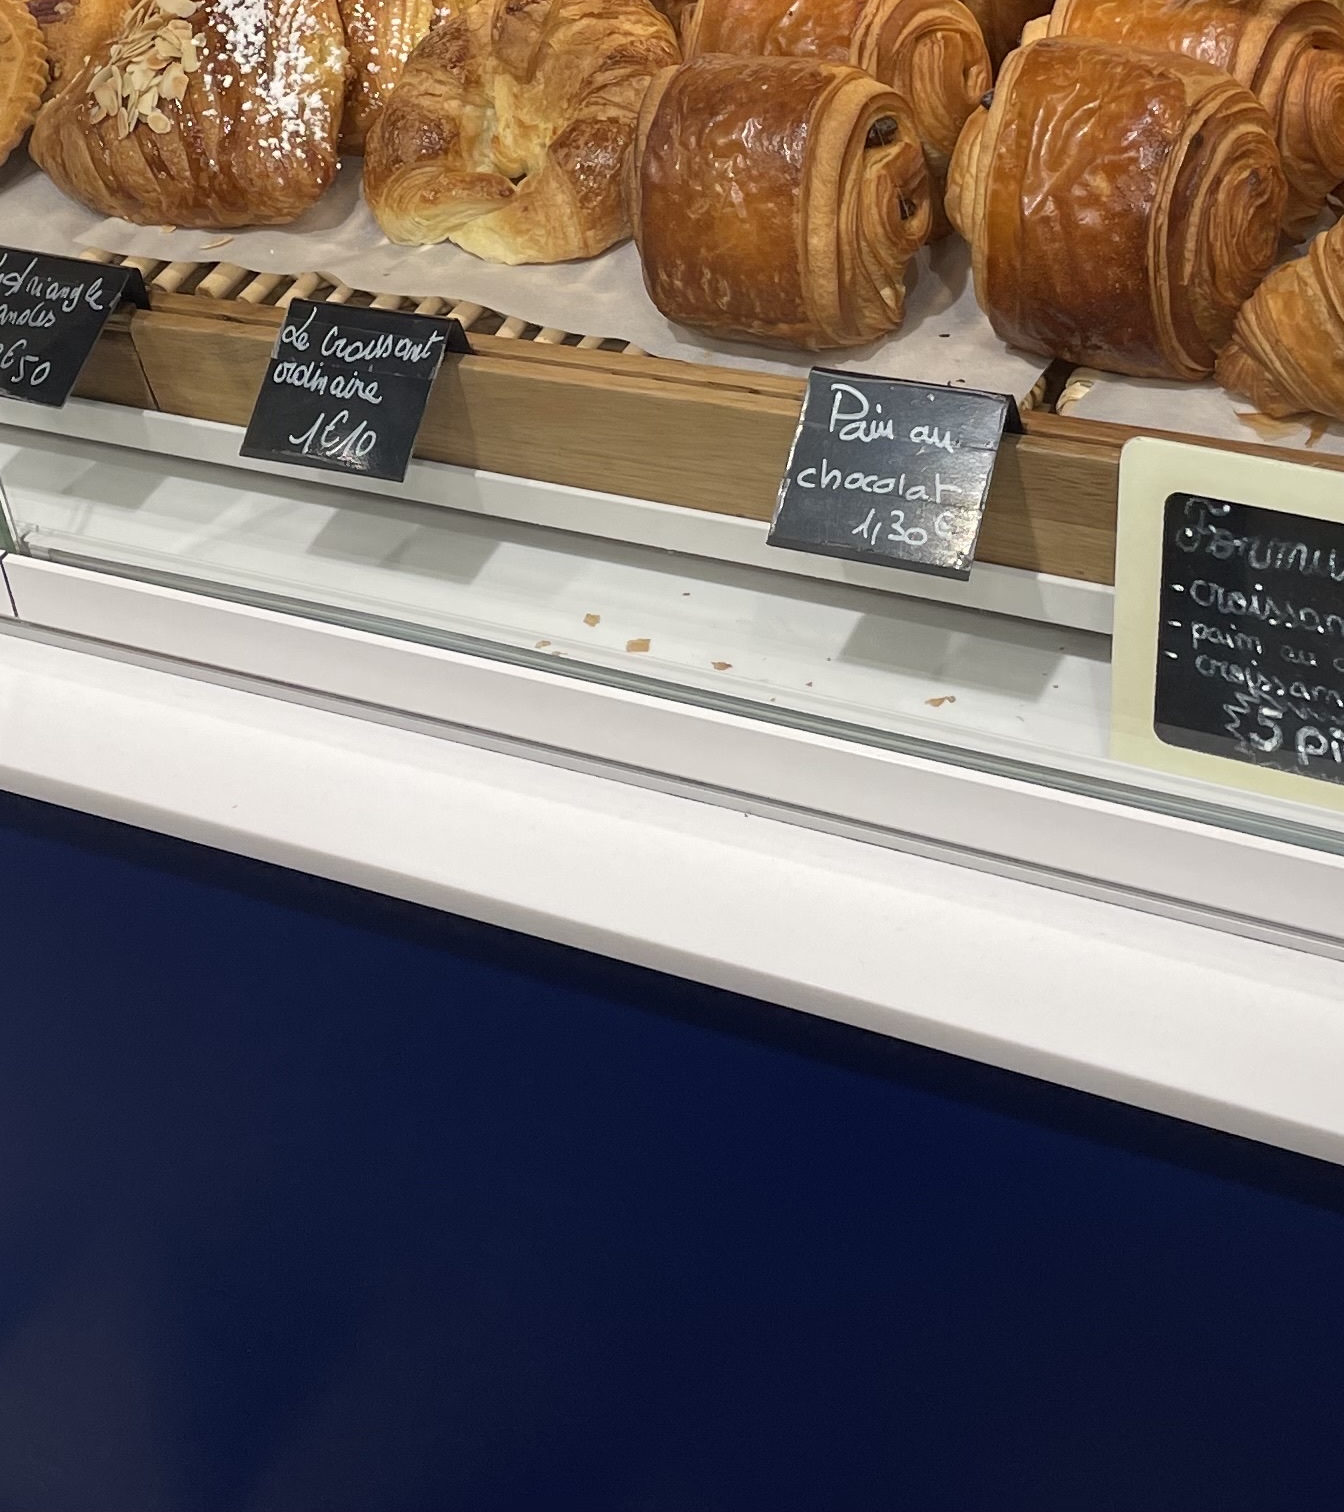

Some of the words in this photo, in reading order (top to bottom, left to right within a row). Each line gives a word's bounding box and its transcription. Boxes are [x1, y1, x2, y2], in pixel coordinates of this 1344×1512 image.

[2, 256, 105, 313] triangle
[280, 306, 318, 352] Le
[271, 360, 383, 405] ordinaire
[287, 408, 378, 457] 1€10
[828, 382, 895, 444] Pain
[908, 424, 955, 454] au
[795, 457, 964, 505] chocolat
[1190, 620, 1264, 656] pain
[1280, 644, 1319, 668] au
[1247, 705, 1285, 754] 5
